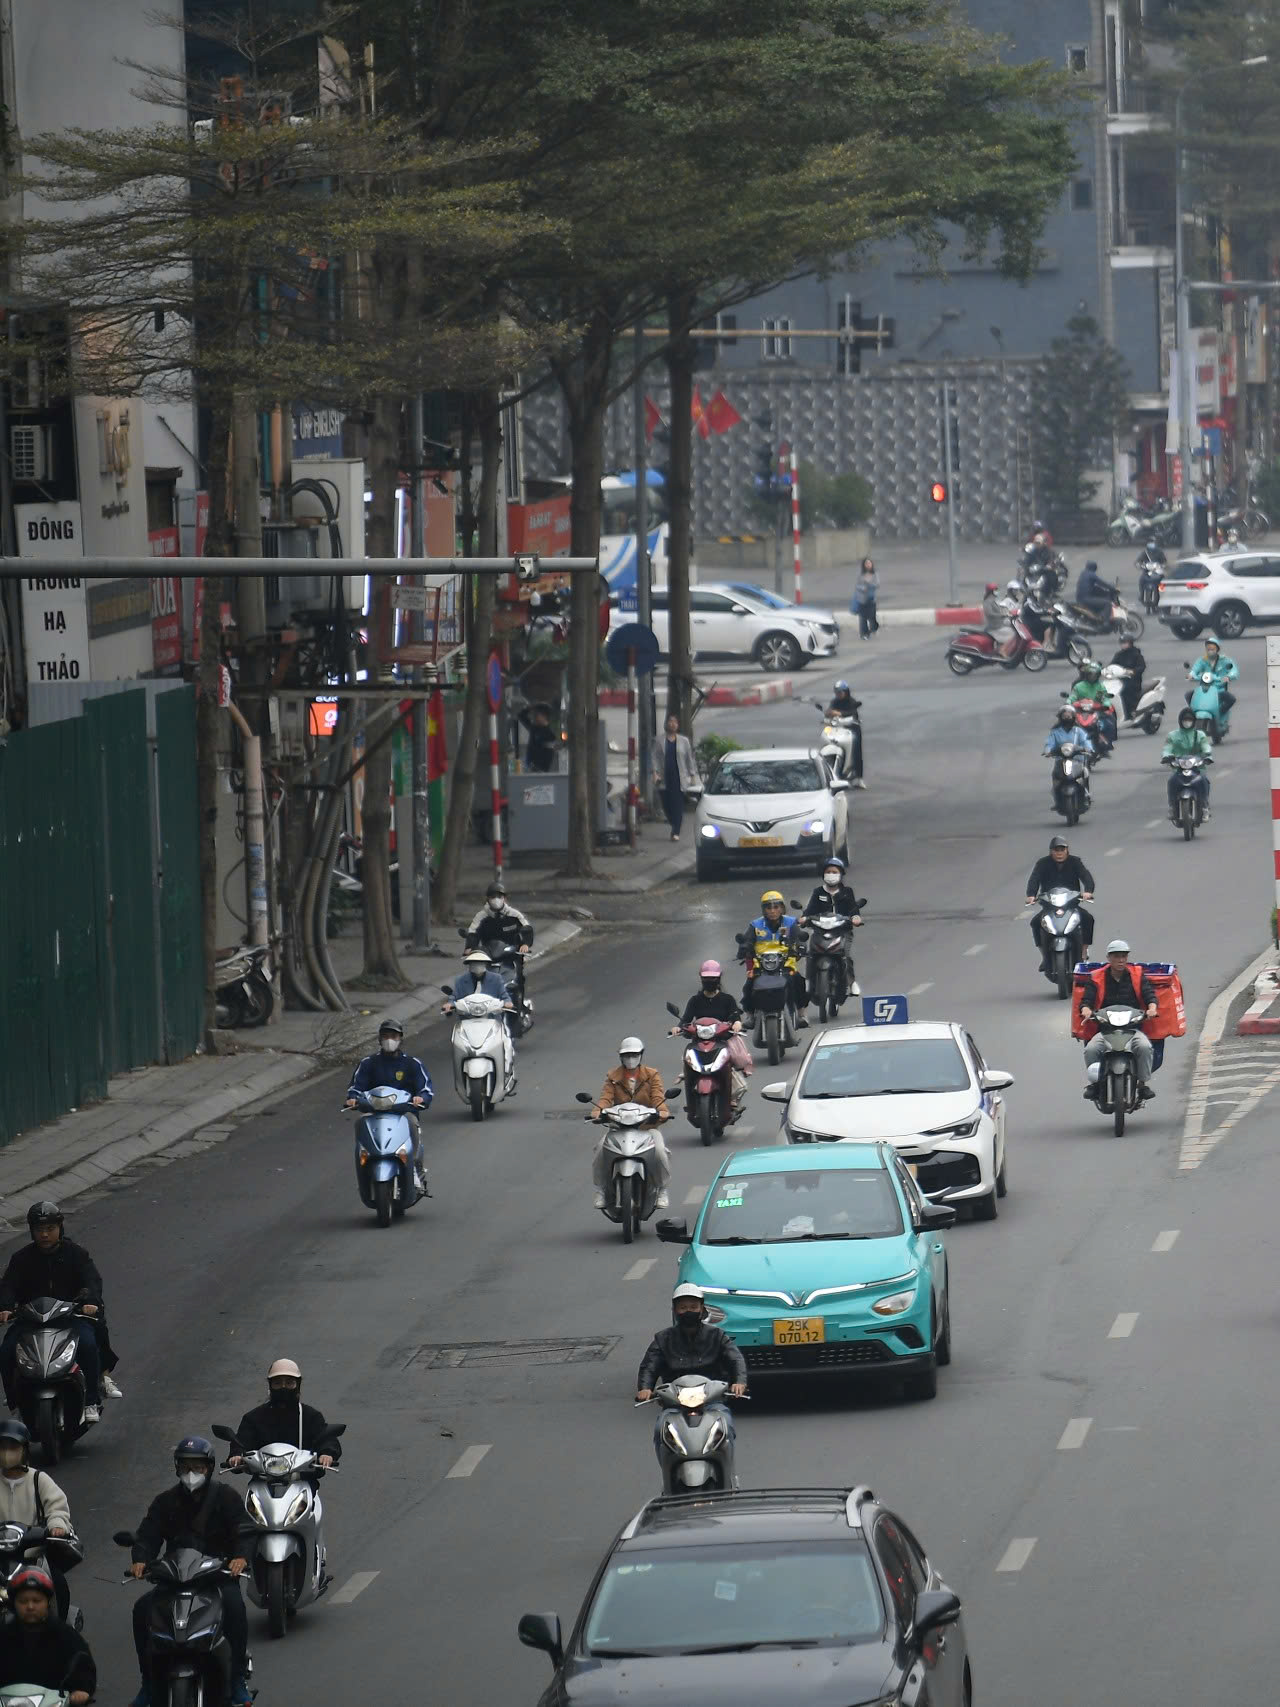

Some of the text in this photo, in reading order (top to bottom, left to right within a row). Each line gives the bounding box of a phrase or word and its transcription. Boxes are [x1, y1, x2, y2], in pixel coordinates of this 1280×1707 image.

[27, 516, 74, 541] ĐÔNG
[44, 610, 67, 634] HẠ
[38, 653, 80, 681] THẢO
[874, 999, 897, 1023] G7
[780, 1331, 820, 1344] 070.12
[787, 1320, 809, 1331] 29K
